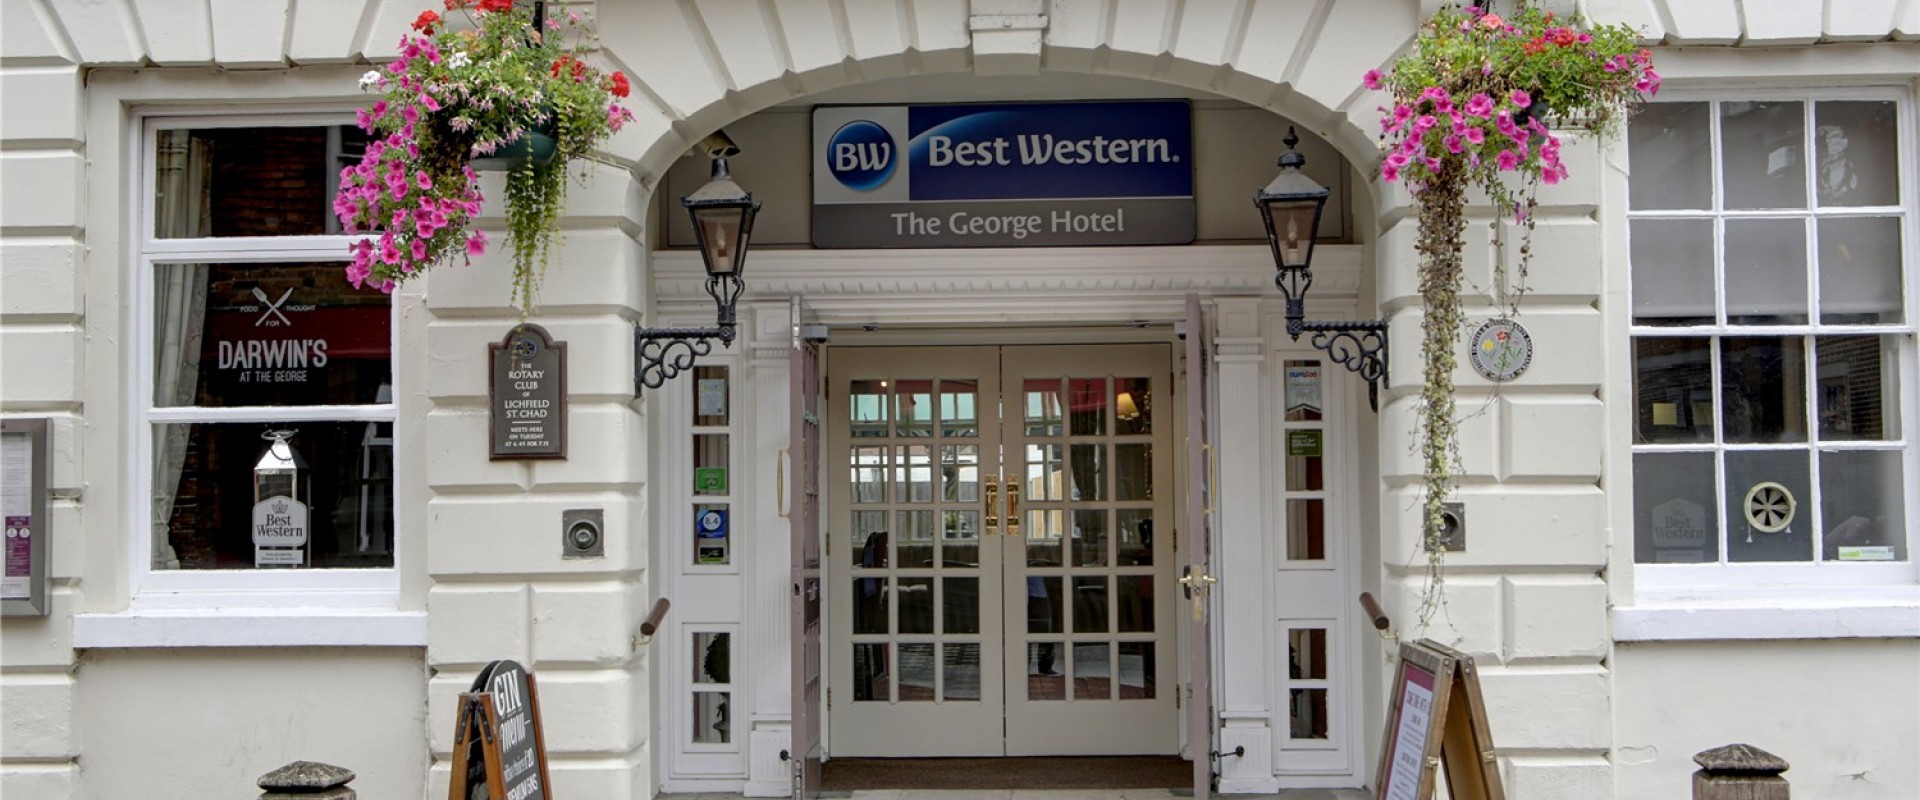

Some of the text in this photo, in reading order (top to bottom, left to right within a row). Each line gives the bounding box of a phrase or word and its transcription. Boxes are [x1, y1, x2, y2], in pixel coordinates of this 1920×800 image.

[834, 142, 890, 172] BW
[928, 134, 1011, 168] Best
[891, 209, 1126, 240] The George Hotel
[286, 304, 316, 312] THOUGHT
[218, 338, 328, 369] DARWIN'S
[239, 370, 308, 382] AT THE GEORGE
[508, 370, 545, 379] ROTARY
[514, 381, 538, 390] CLUB
[504, 399, 550, 409] LICHFIELD
[519, 410, 548, 418] CHAD
[265, 513, 292, 526] Best
[1664, 515, 1690, 528] Best
[256, 524, 303, 538] Western
[1653, 527, 1703, 540] Western
[494, 669, 521, 717] GIN
